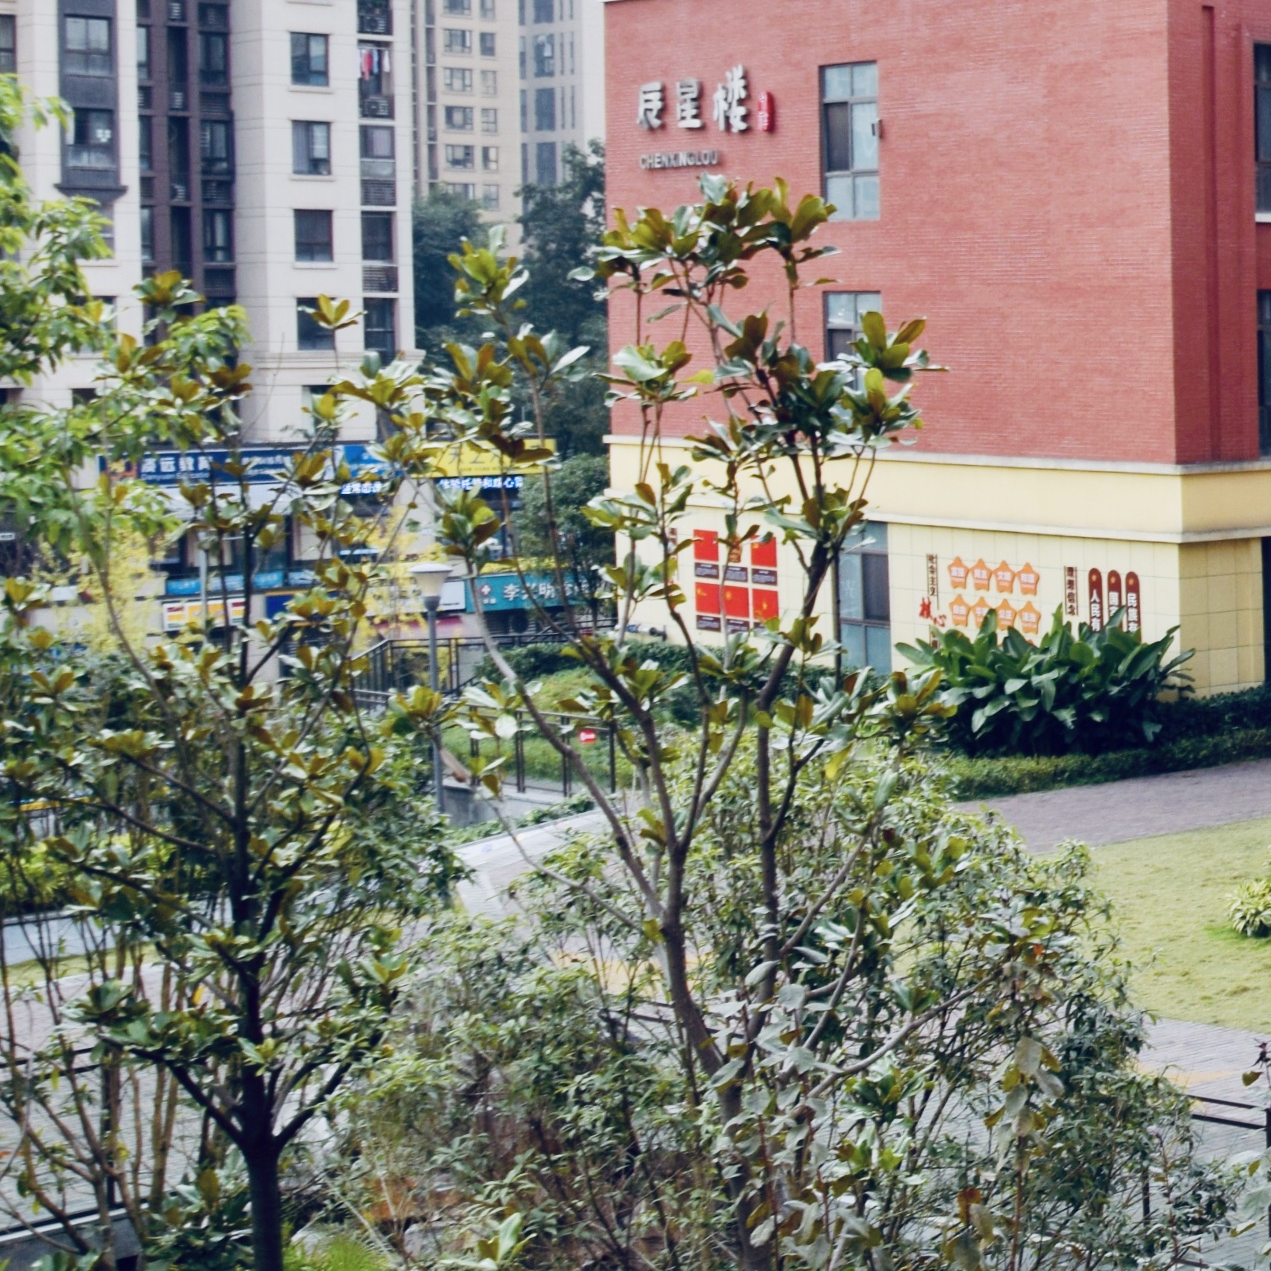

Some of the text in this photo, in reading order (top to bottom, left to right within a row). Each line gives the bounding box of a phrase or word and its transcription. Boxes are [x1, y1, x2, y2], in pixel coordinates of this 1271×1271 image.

[637, 64, 748, 133] 辰星楼
[640, 150, 718, 170] CHENXINGLOU
